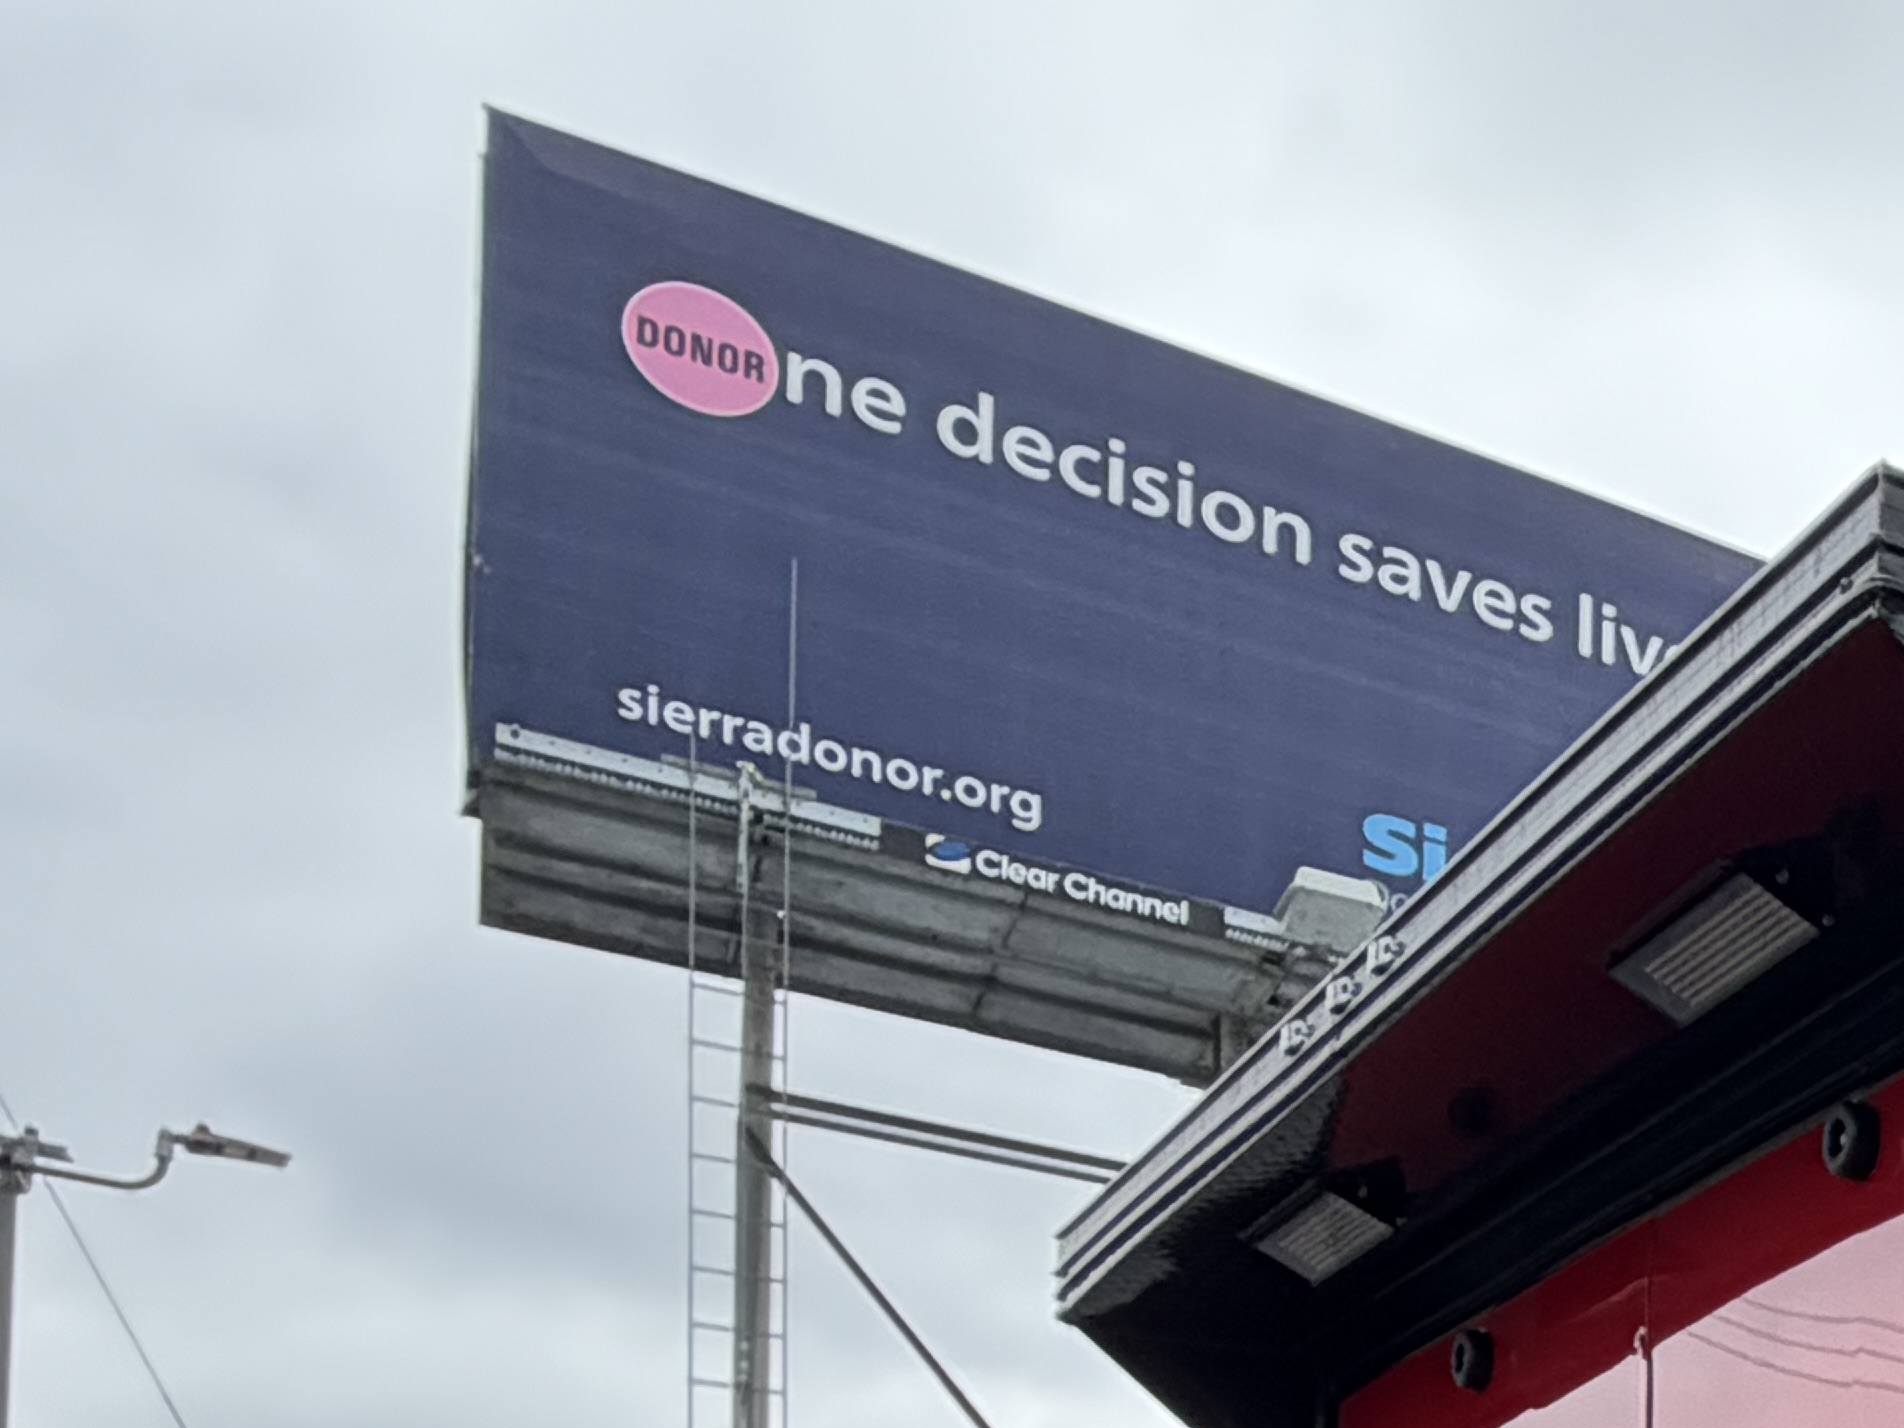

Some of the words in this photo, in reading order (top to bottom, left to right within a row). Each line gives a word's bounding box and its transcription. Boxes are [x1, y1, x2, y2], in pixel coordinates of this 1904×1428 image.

[636, 314, 766, 384] DONOR
[936, 391, 1312, 566] decision
[1338, 532, 1554, 642] saves
[616, 684, 1043, 832] sierradonor.org
[975, 848, 1059, 894] Clear
[1063, 871, 1190, 926] Channel
